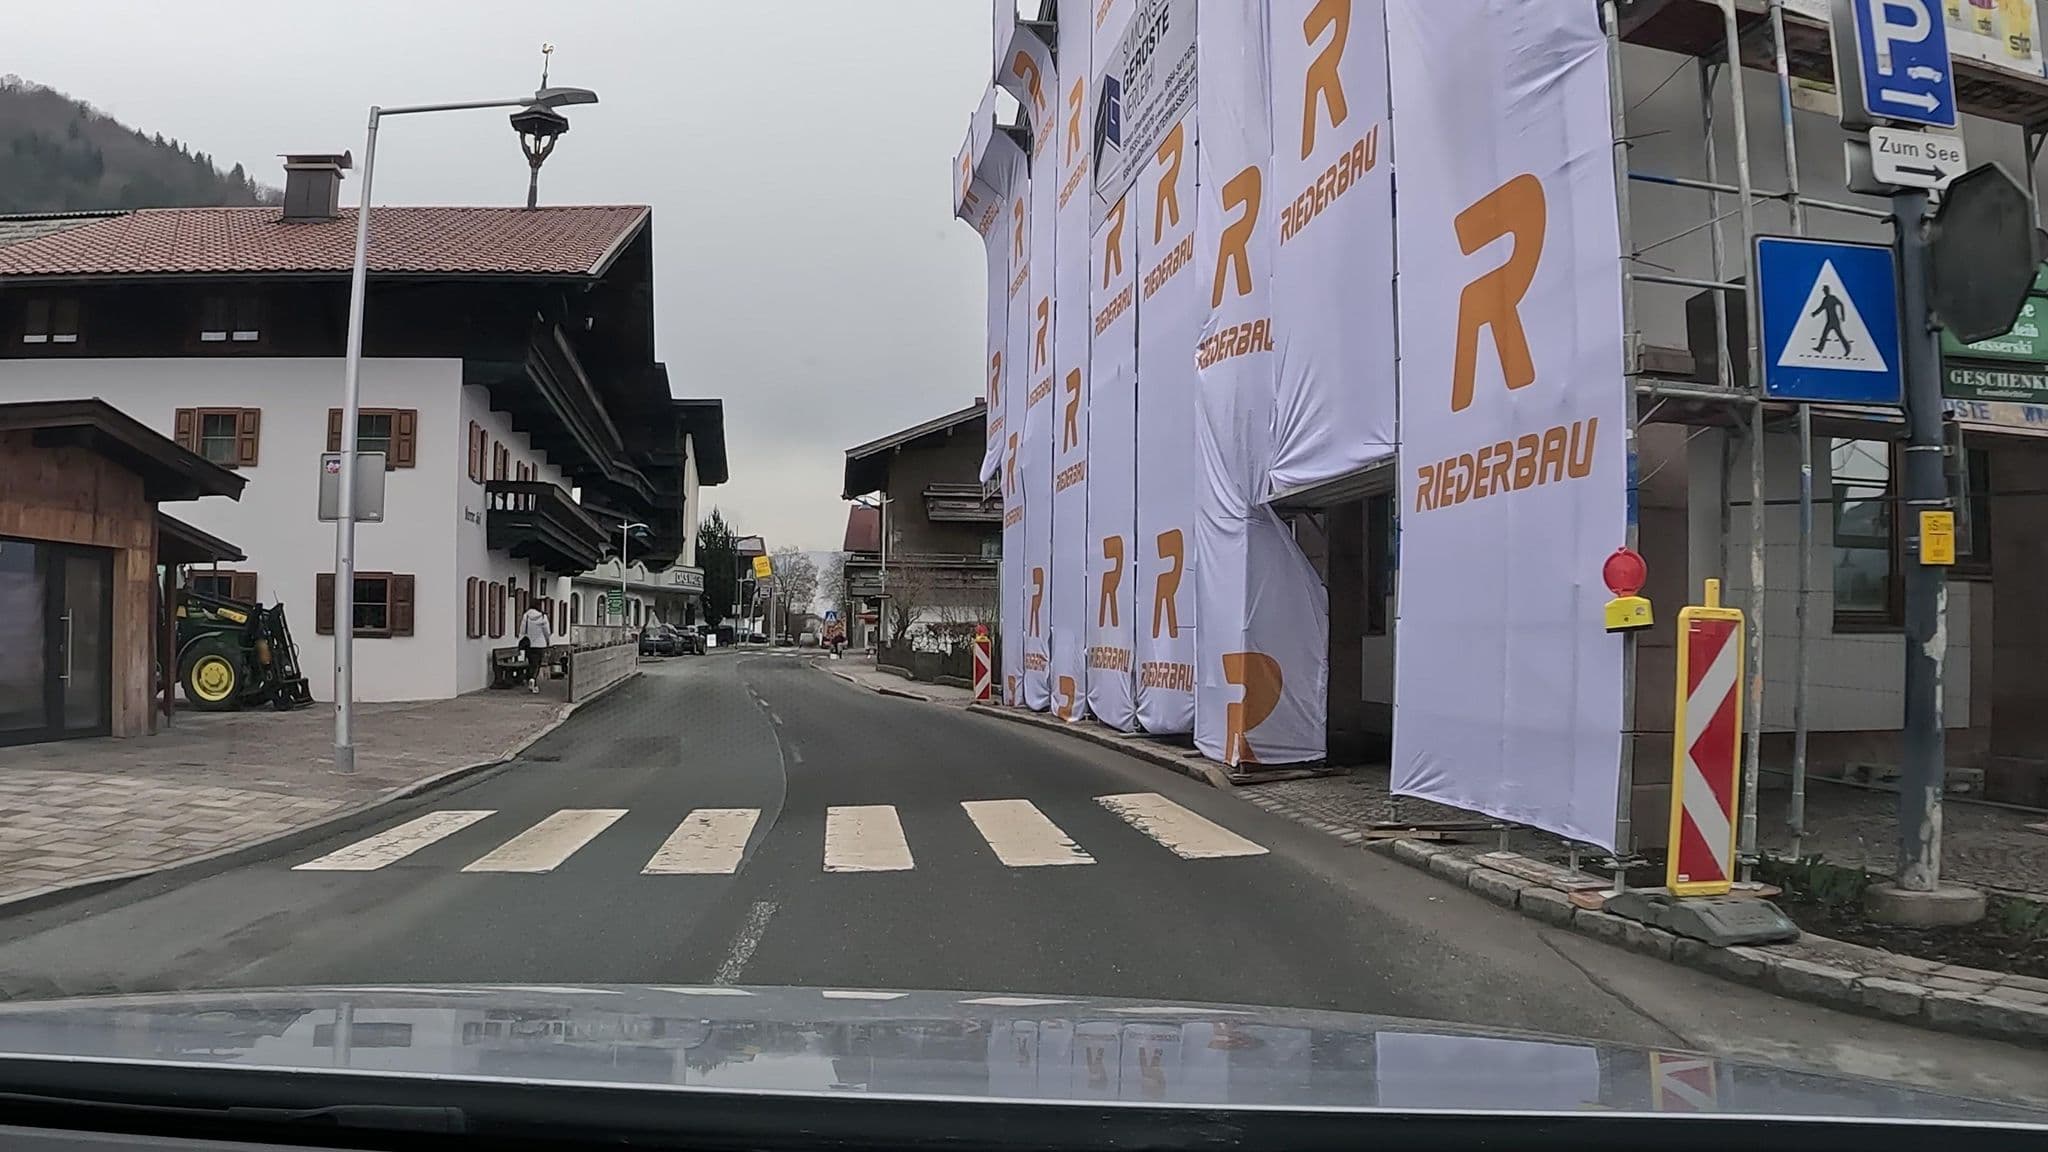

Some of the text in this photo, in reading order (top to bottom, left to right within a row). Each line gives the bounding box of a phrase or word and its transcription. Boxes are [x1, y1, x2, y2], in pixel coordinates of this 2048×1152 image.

[1869, 0, 1932, 76] P
[1280, 124, 1378, 247] RIEDERBAU
[1879, 136, 1959, 162] Zum See
[1212, 165, 1262, 309] R
[1451, 173, 1547, 412] R
[1416, 417, 1599, 513] RIEDERBAU
